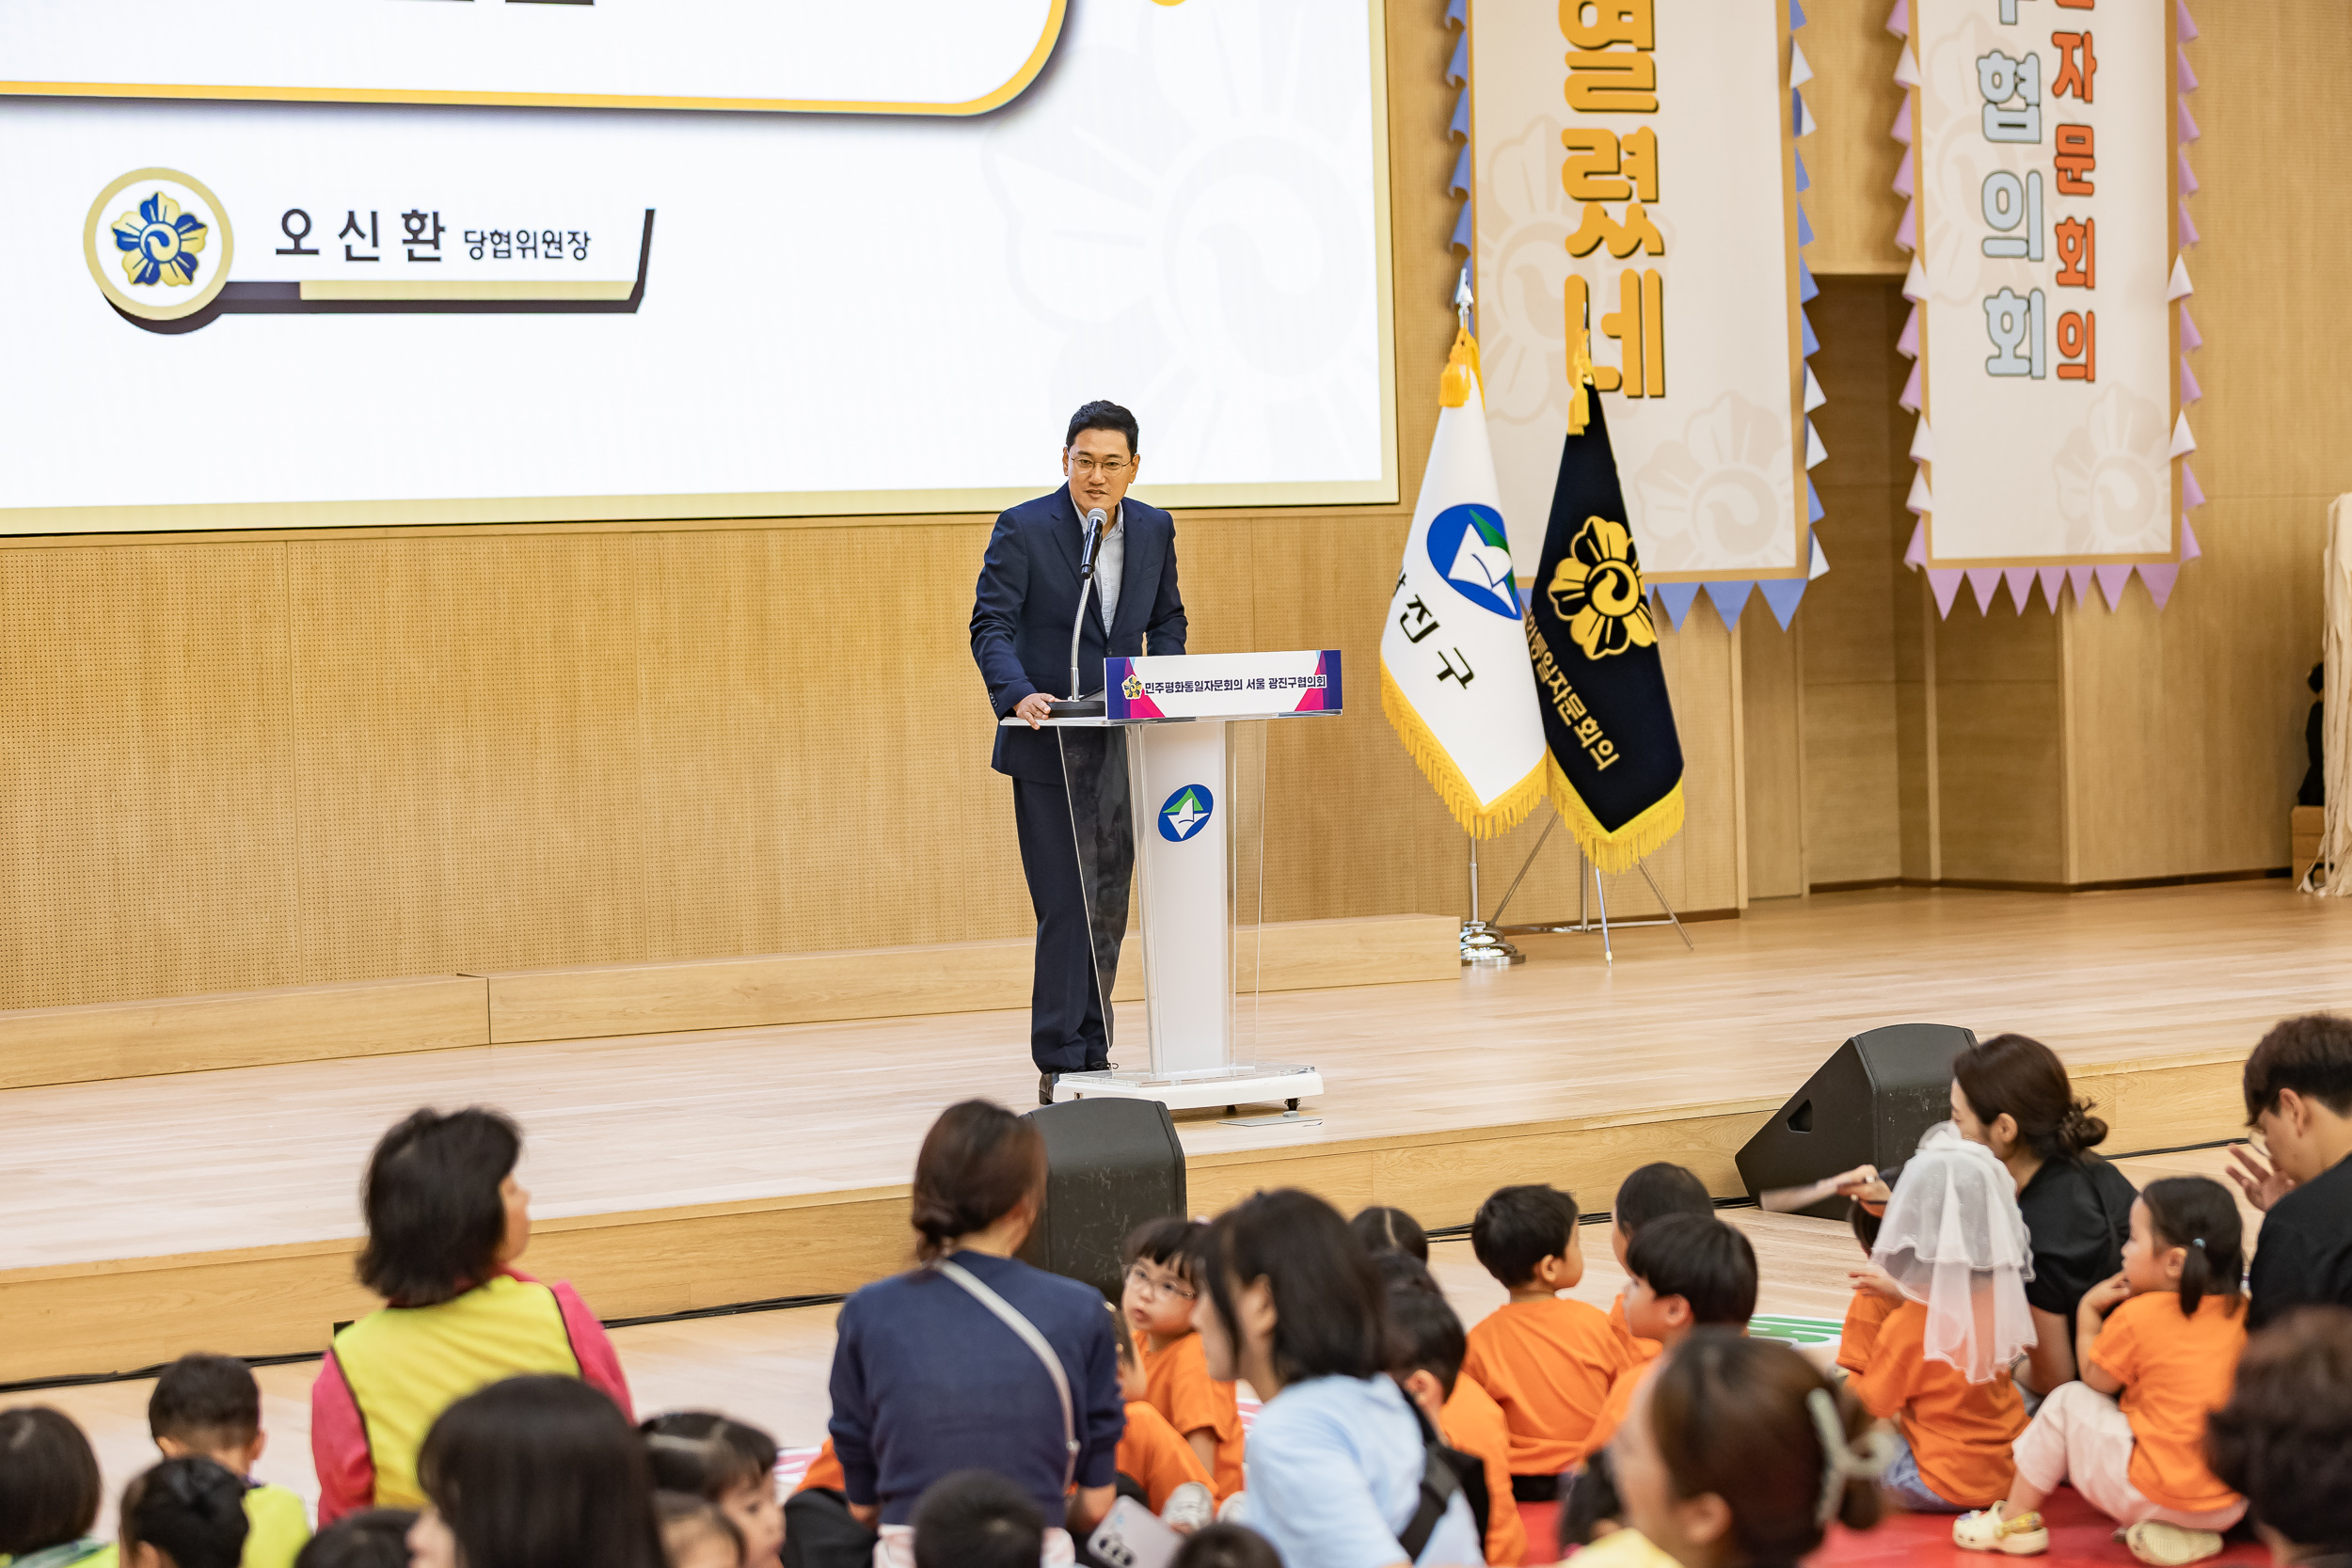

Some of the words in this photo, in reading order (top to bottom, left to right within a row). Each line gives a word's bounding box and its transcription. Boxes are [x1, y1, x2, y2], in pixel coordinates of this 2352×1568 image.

[464, 230, 592, 261] 당협위원장
[1976, 0, 2046, 380] 협의회
[2052, 0, 2097, 383] 자문회의
[1144, 678, 1243, 694] 민주평화통일자문회의
[1246, 677, 1265, 690] 서울
[1268, 675, 1327, 689] 광진구협의회
[1392, 573, 1474, 689] 진구
